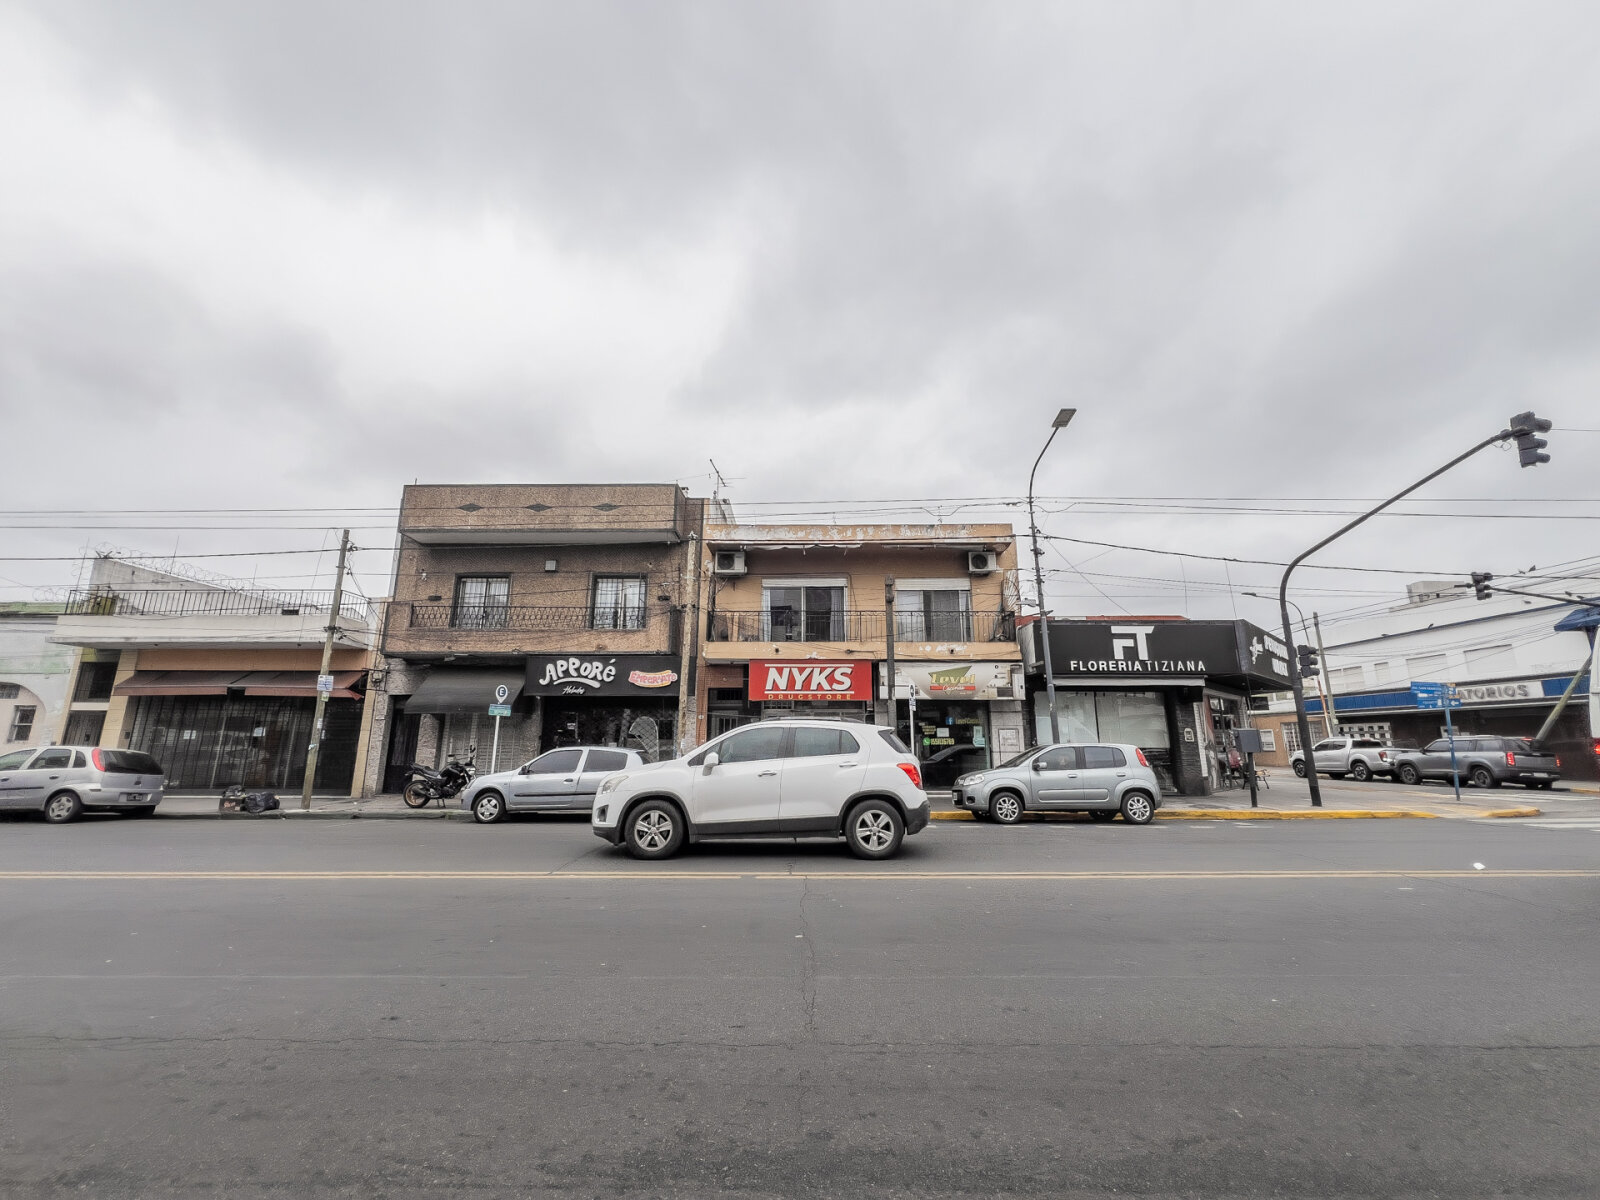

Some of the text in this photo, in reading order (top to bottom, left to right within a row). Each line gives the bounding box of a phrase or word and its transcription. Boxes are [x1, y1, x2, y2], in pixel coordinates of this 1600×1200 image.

[1110, 625, 1155, 661] FT
[1070, 660, 1206, 672] FLORERIA TIZIANA
[765, 667, 853, 691] NYKS
